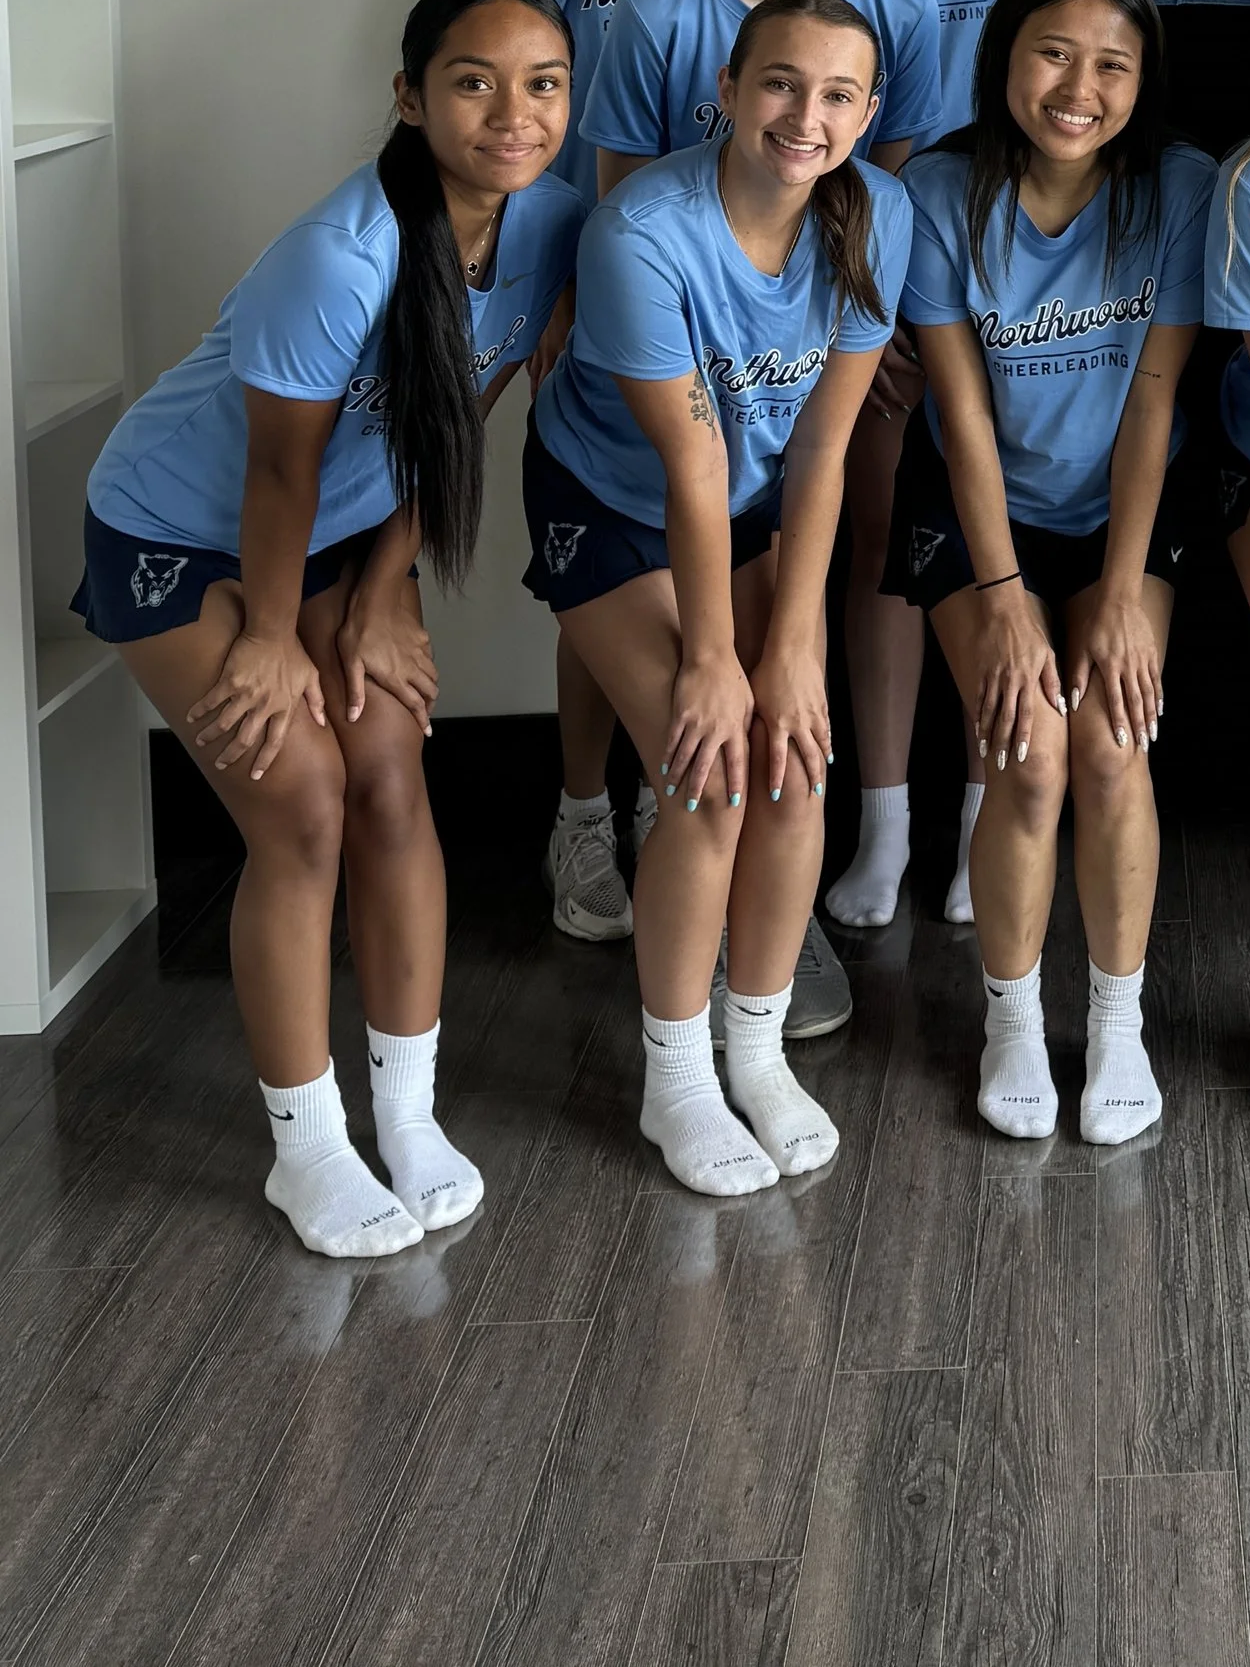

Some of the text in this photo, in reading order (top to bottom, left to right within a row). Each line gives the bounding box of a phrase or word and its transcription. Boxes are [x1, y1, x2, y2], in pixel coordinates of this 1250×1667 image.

[969, 276, 1157, 351] Northwood
[994, 352, 1130, 378] CHEERLEADING
[1001, 1096, 1040, 1104] DRI-FIT
[1103, 1098, 1144, 1107] DRI-FIT
[420, 1180, 457, 1201] DRI-FIT
